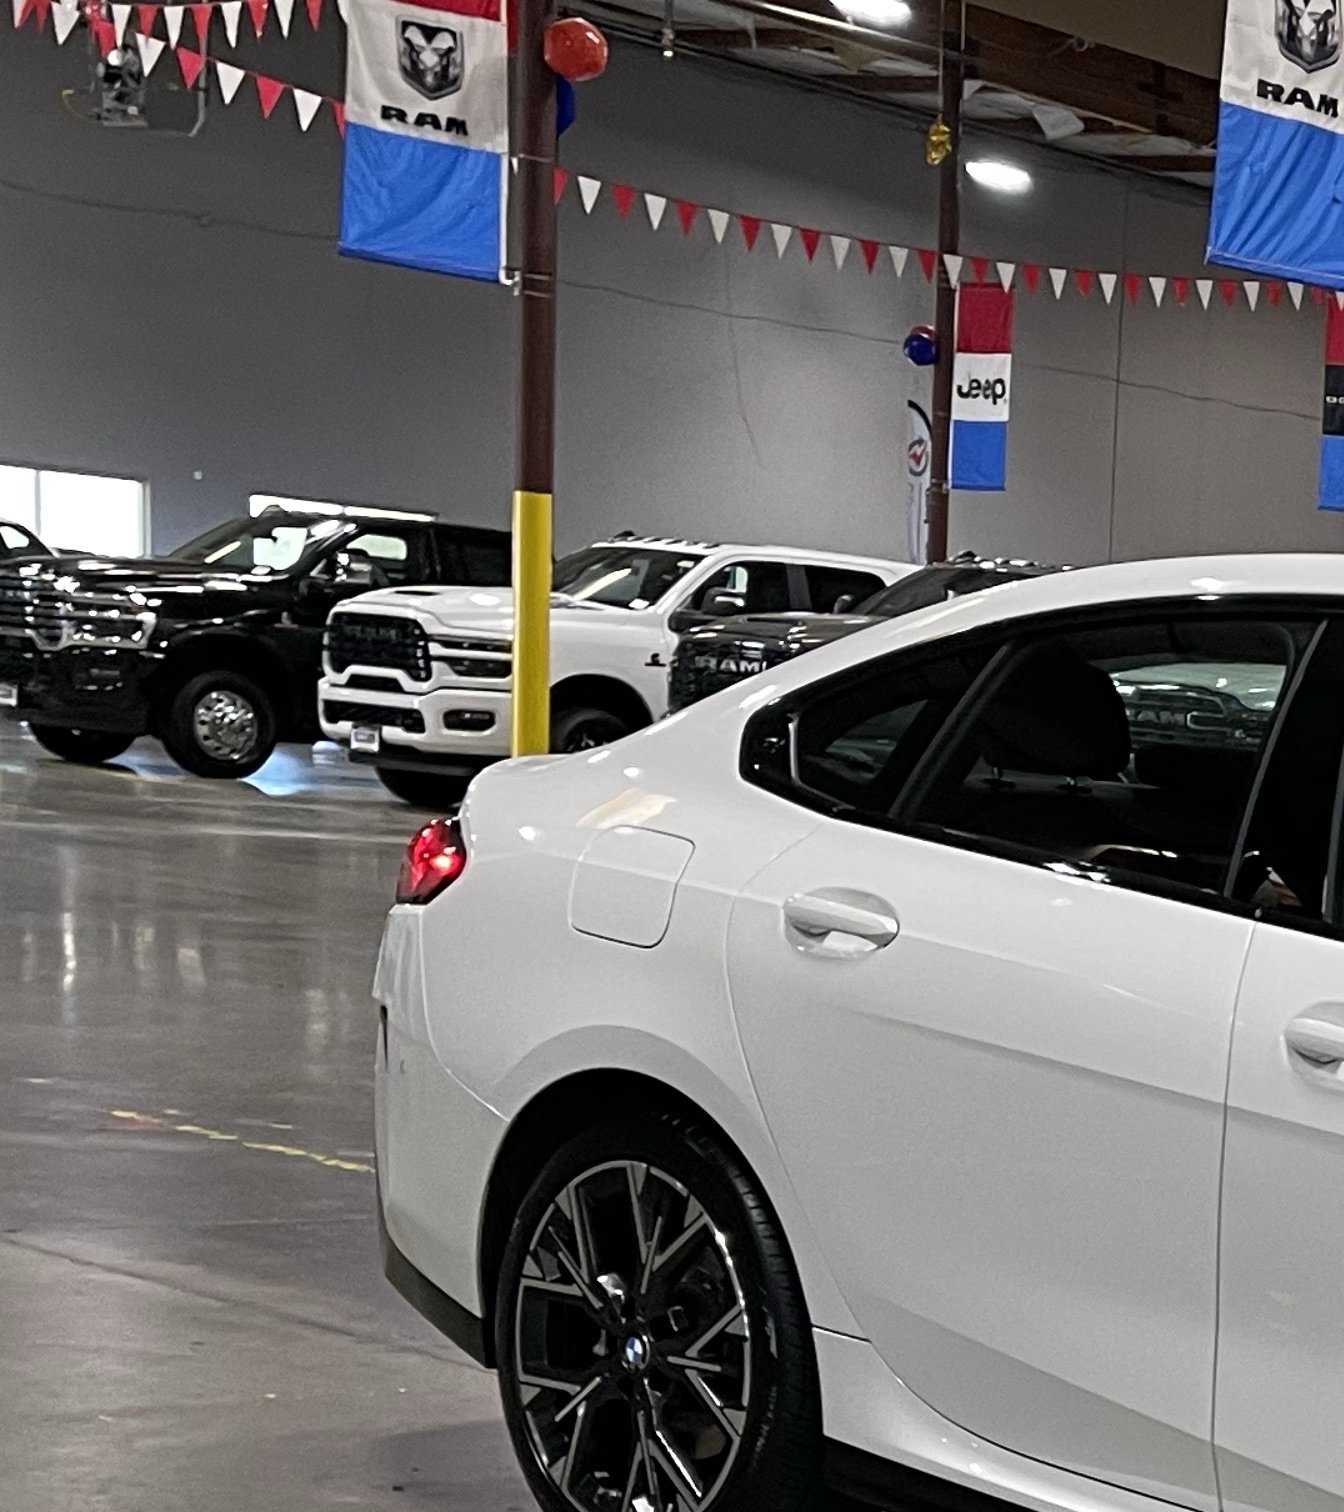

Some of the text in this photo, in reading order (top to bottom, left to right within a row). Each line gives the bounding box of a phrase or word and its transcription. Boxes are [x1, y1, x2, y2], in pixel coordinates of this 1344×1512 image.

[1256, 78, 1338, 118] RAM
[380, 104, 468, 136] RAM
[956, 378, 1006, 405] Jeep
